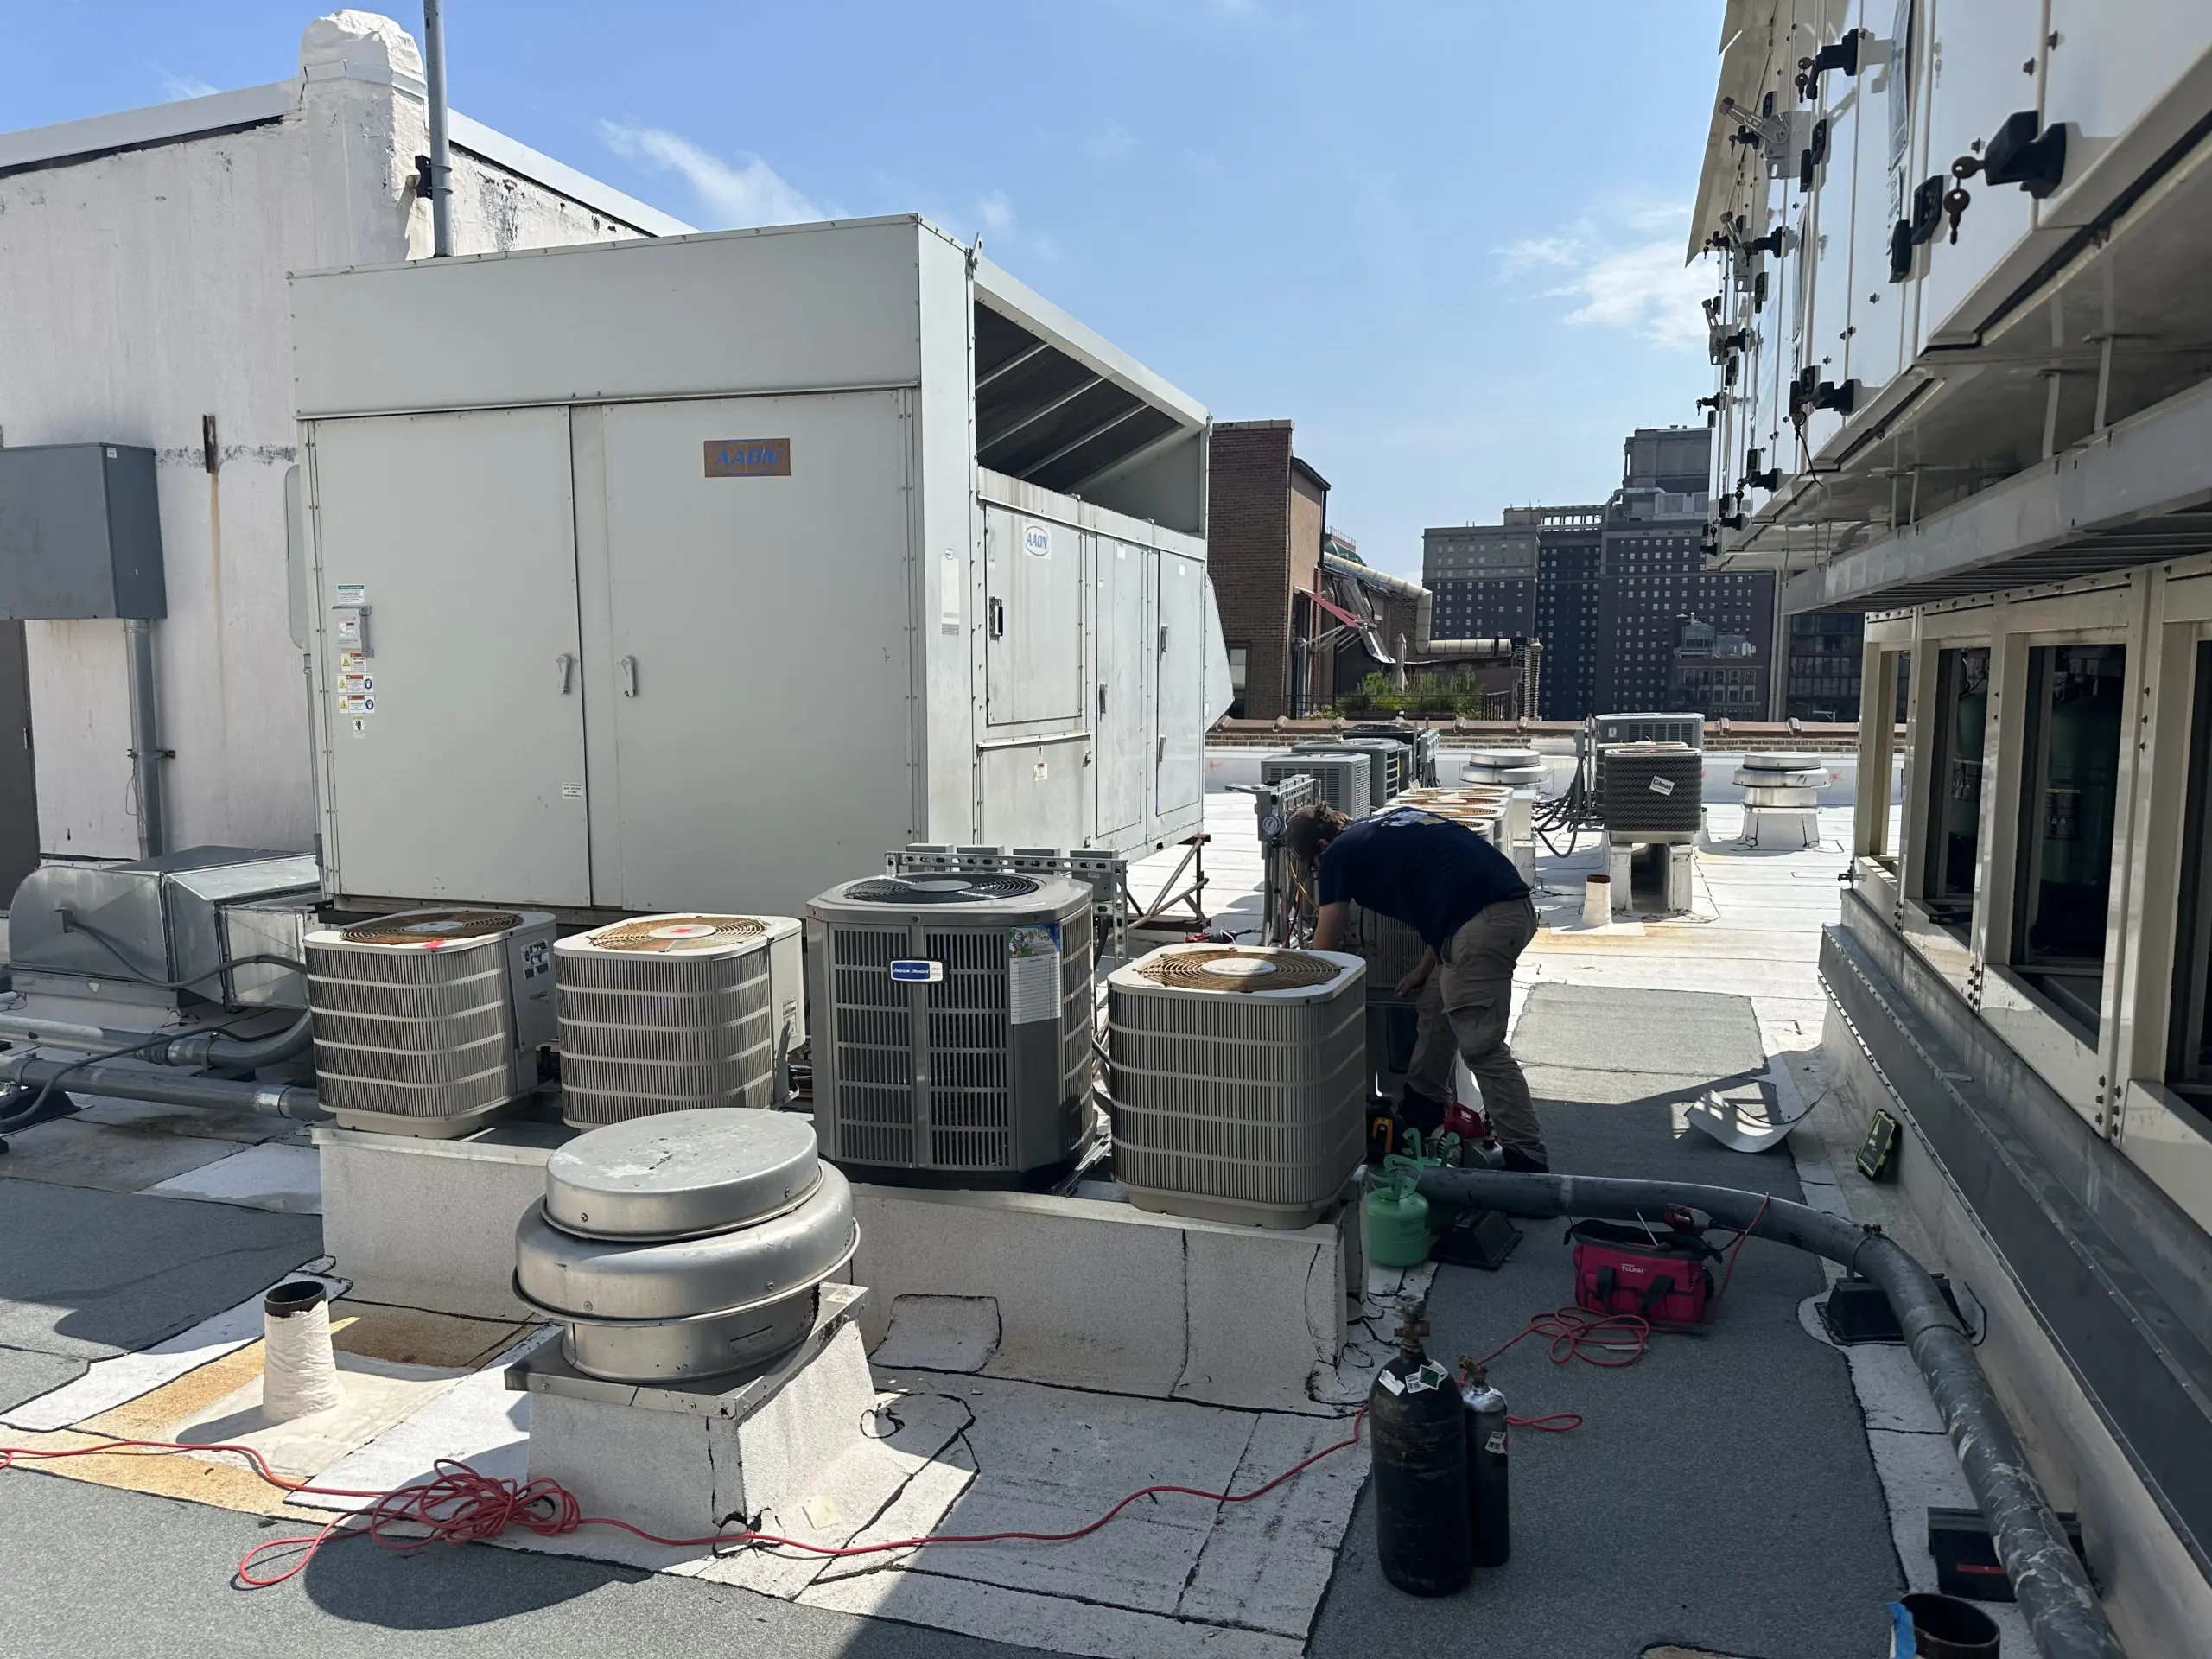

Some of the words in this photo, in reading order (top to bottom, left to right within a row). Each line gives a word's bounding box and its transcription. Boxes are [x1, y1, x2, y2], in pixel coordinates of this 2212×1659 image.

[715, 448, 778, 466] AAON
[1026, 532, 1048, 549] AAON
[1653, 779, 1672, 791] Gibson
